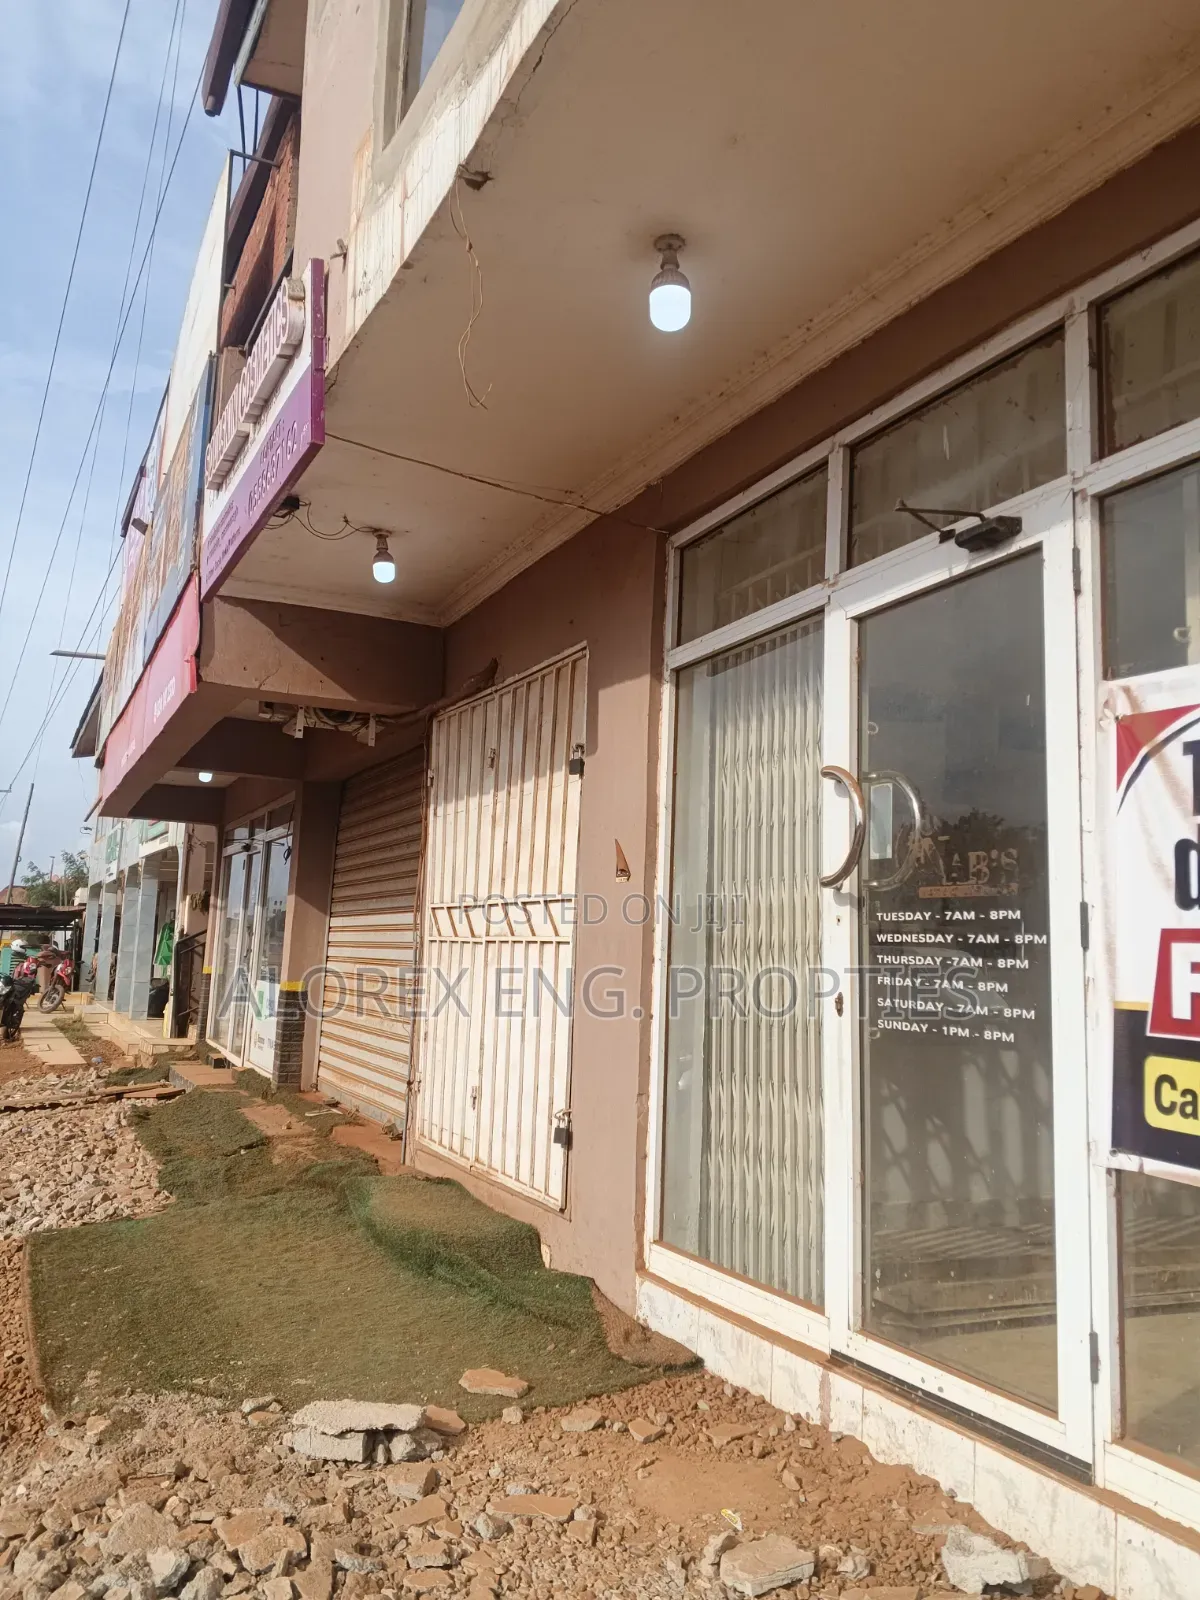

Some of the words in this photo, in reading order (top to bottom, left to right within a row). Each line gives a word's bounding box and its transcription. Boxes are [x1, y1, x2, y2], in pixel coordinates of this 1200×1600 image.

[239, 277, 289, 423] COSMETICS
[877, 911, 932, 921] TUESDAY
[944, 911, 976, 920] 7AM
[989, 910, 1021, 920] 8PM
[877, 933, 954, 943] WEDNESDAY
[967, 934, 1000, 944] 7AM
[1014, 934, 1047, 944] 8PM
[877, 955, 942, 966] THURSDAY
[997, 959, 1029, 969] 8PM
[877, 976, 921, 987] FRIDAY
[934, 979, 964, 990] 7AM
[978, 982, 1008, 993] 8PM
[877, 997, 944, 1012] SATURDAY
[957, 1004, 988, 1016] 7AM
[1003, 1008, 1035, 1020] 8PM
[877, 1019, 928, 1033] SUNDAY
[942, 1026, 970, 1038] 1PM
[983, 1031, 1015, 1043] 8PM
[1154, 1074, 1200, 1121] Ca
